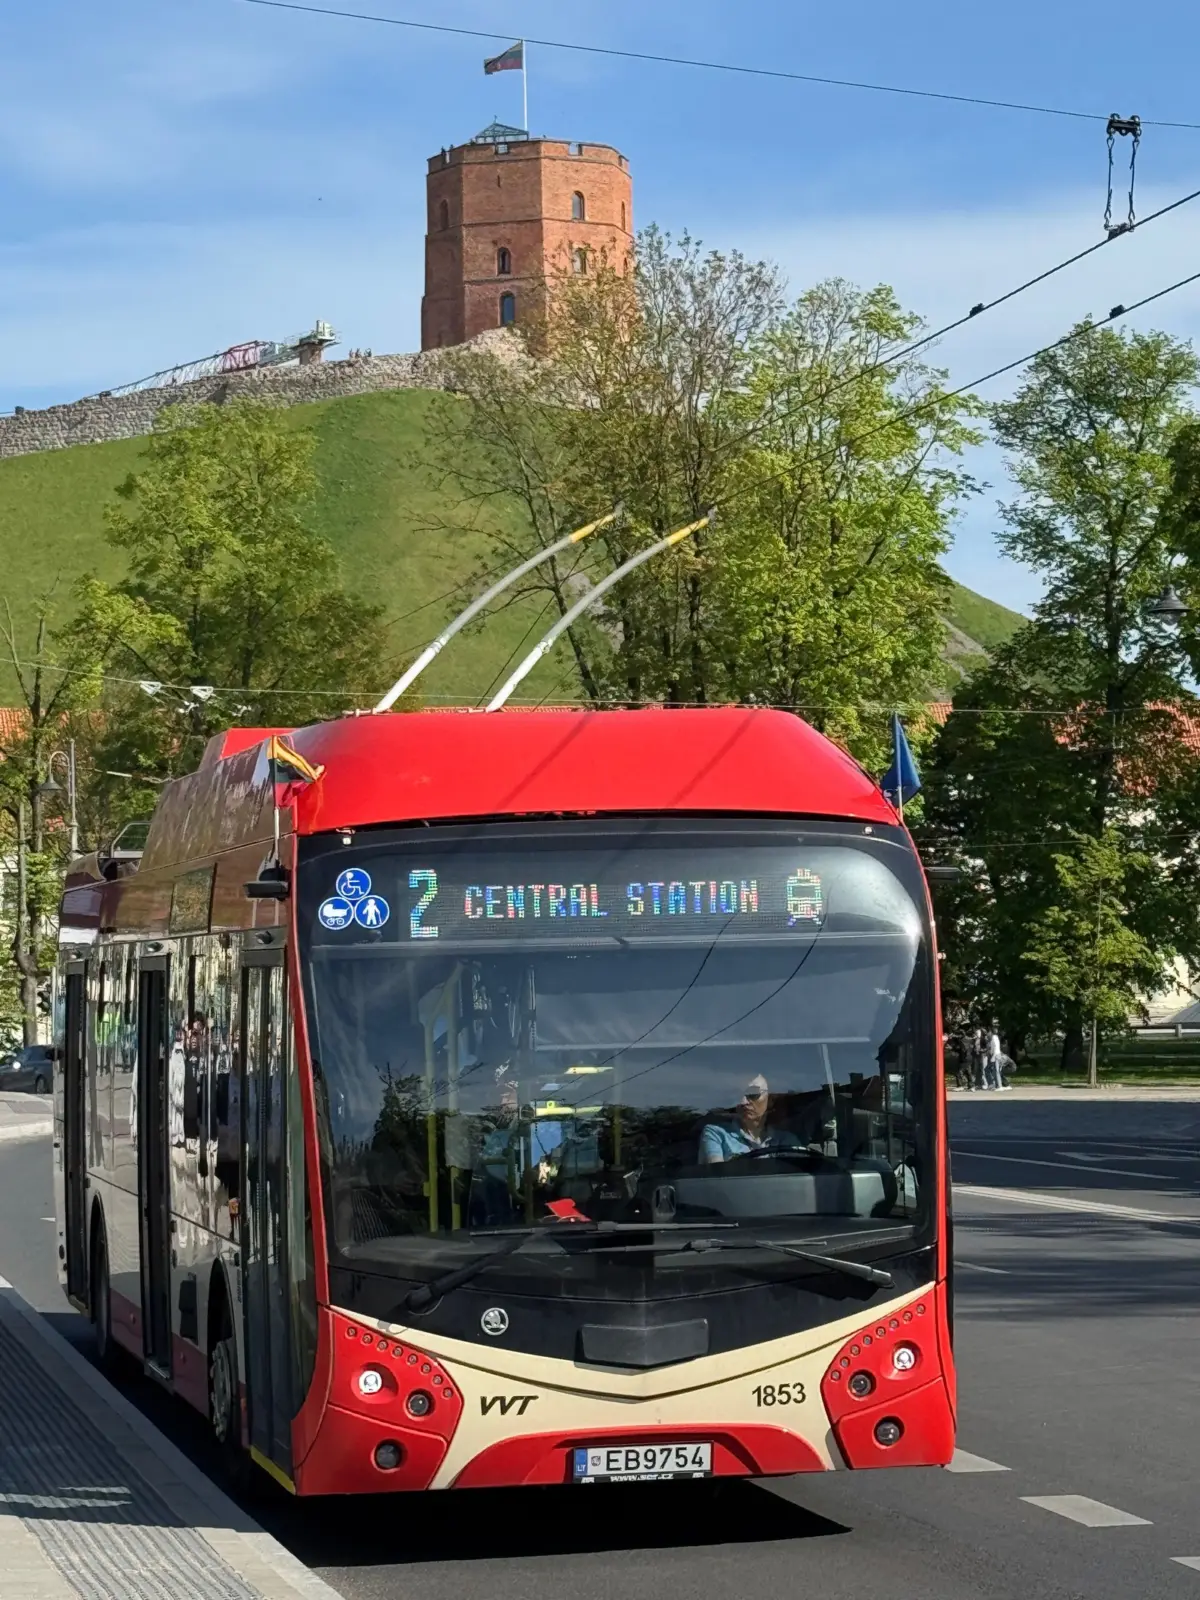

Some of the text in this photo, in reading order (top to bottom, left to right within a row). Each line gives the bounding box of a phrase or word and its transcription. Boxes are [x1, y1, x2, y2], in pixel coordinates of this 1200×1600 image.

[409, 869, 758, 937] 2 CENTRAL STATION
[480, 1396, 539, 1416] VVT
[751, 1382, 806, 1407] 1853
[577, 1464, 586, 1472] LT
[606, 1446, 704, 1471] EB9754
